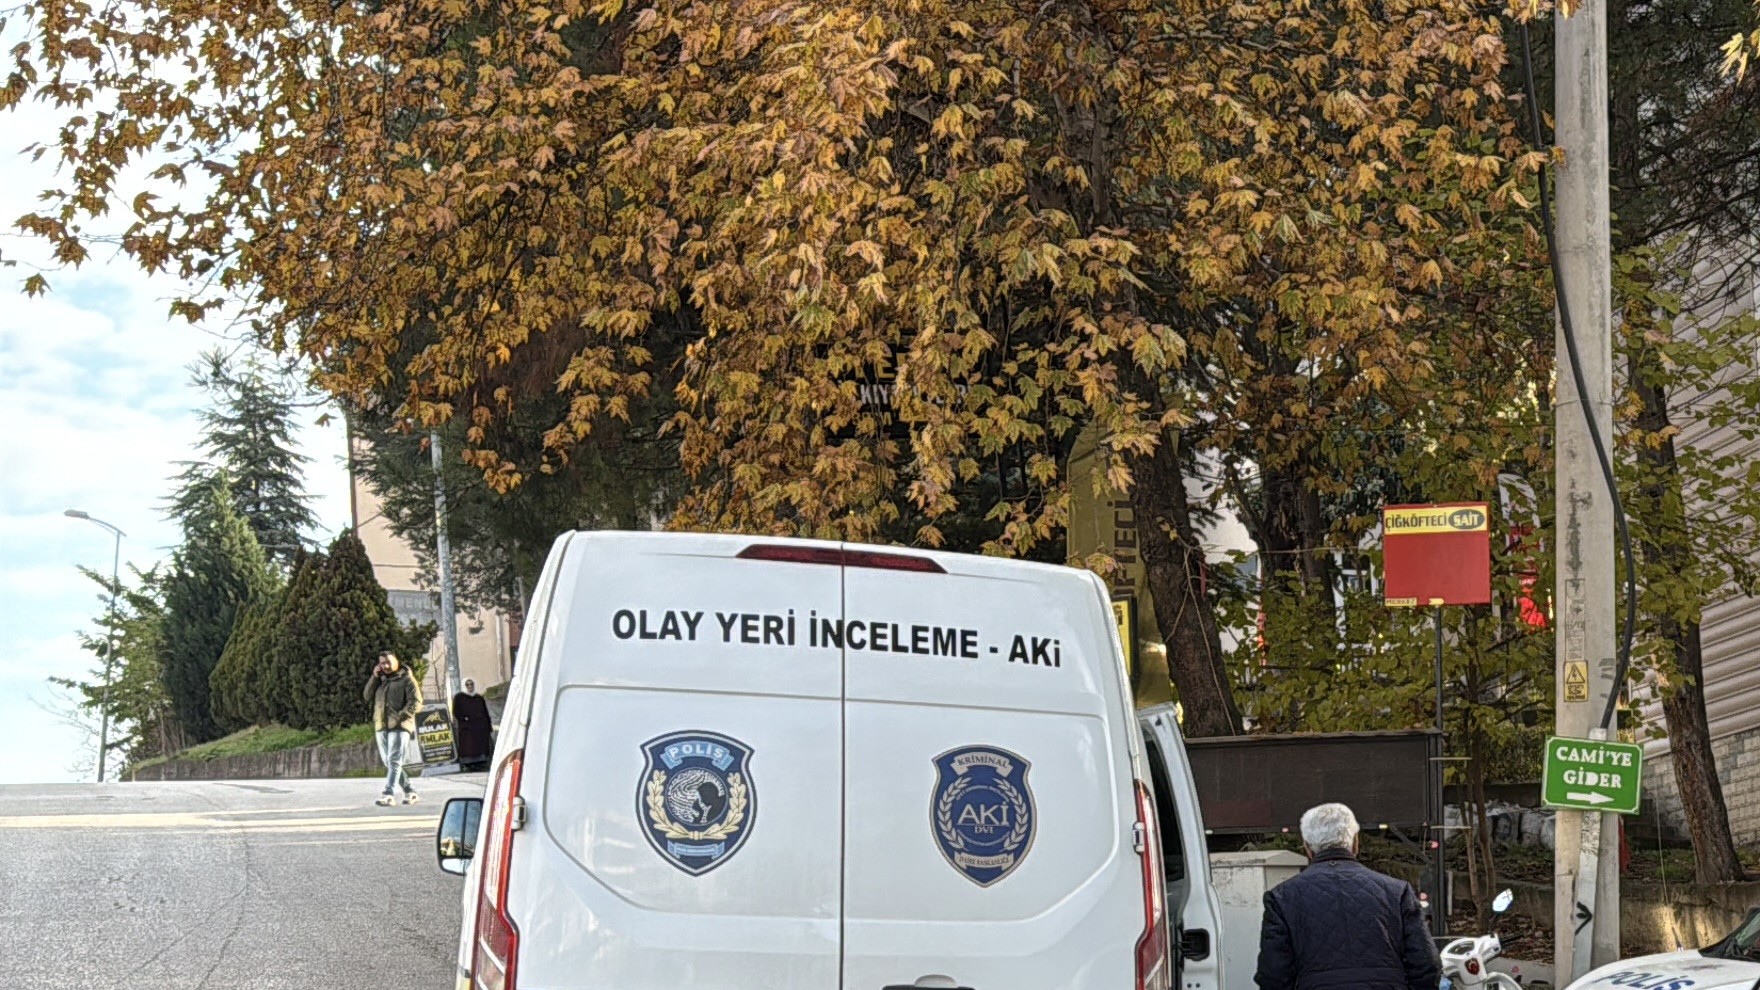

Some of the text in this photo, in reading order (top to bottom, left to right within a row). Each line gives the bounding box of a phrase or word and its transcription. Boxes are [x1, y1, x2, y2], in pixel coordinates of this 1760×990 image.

[1453, 511, 1480, 527] SAİT
[612, 608, 703, 641] OLAY
[714, 608, 796, 646] YERİ
[809, 609, 979, 659] İNCELEME
[668, 744, 724, 758] POLİS
[957, 754, 1008, 768] KRİMİNAL
[1556, 745, 1633, 767] CAMİ'YE
[1563, 766, 1622, 789] GİDER
[957, 800, 1010, 826] AKİ
